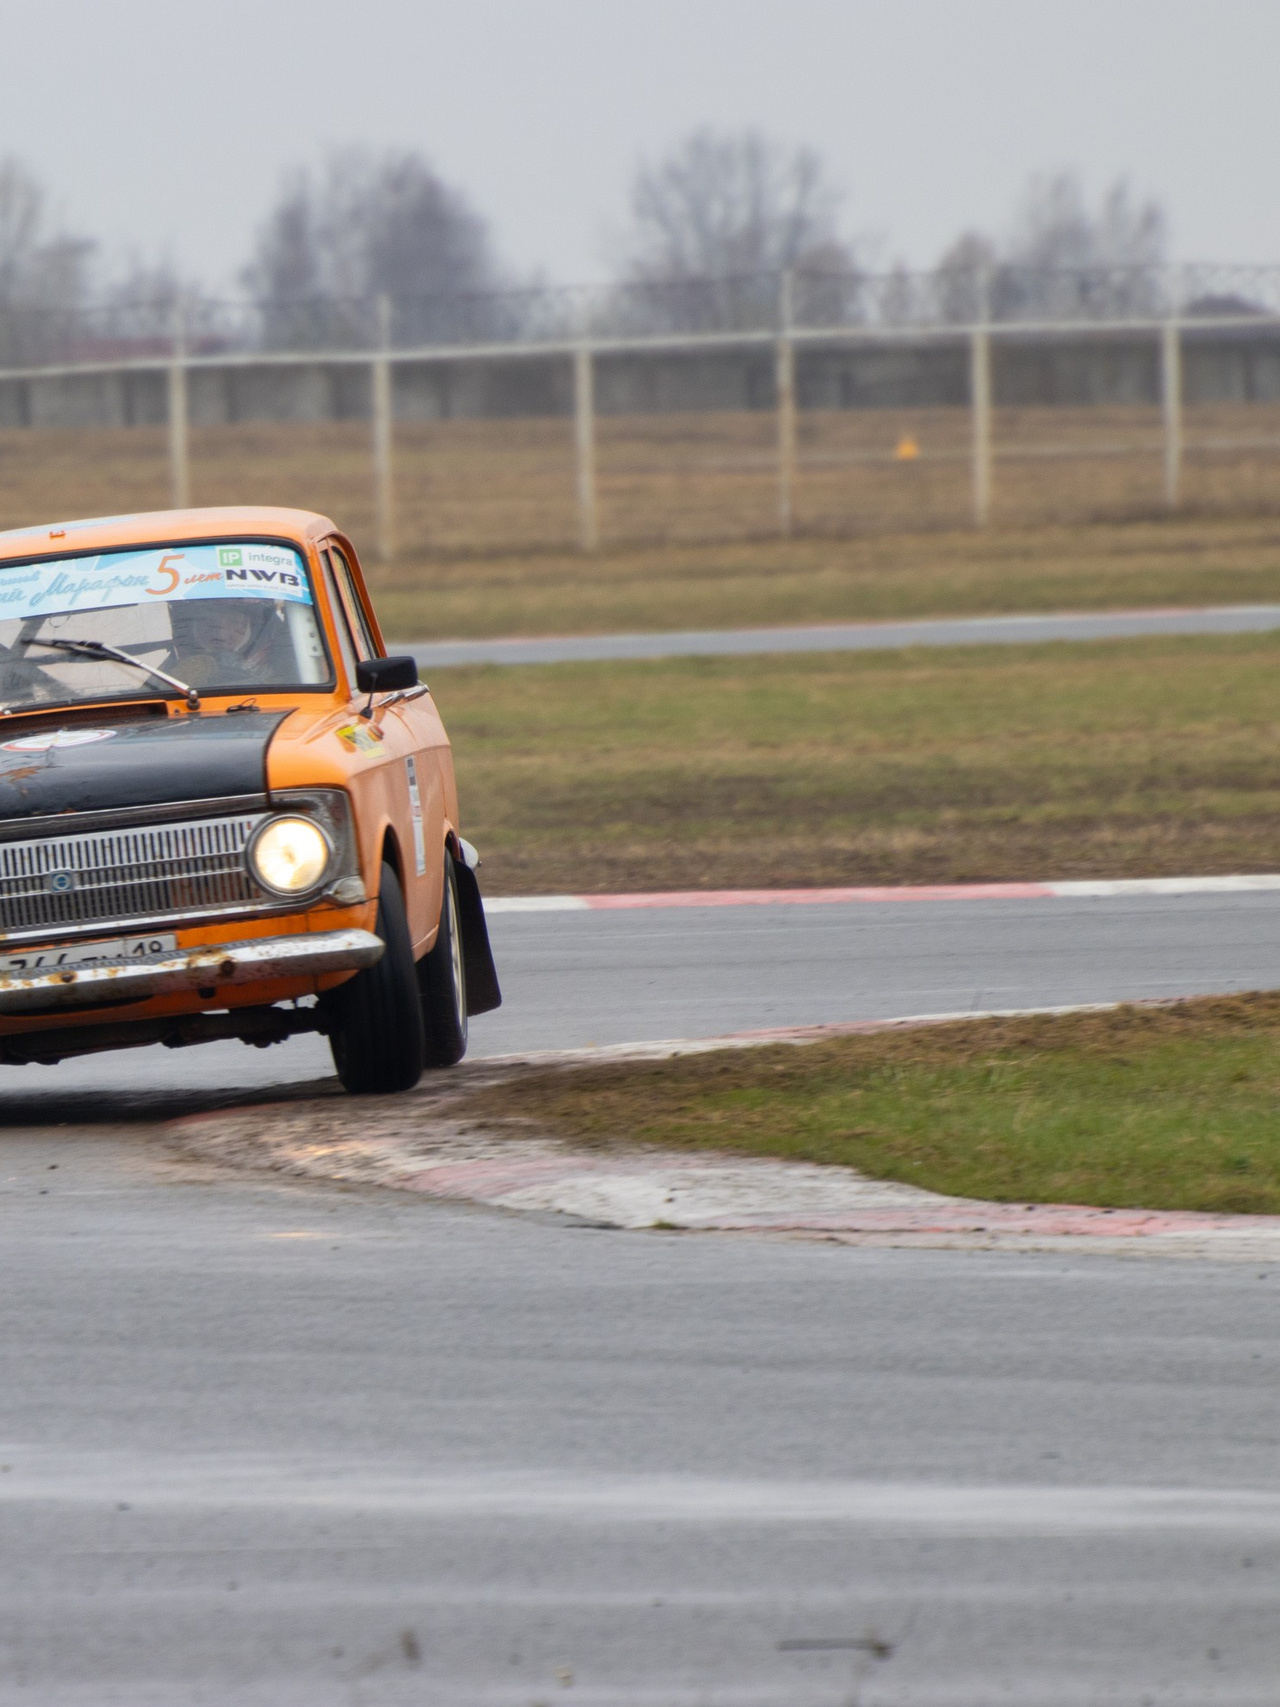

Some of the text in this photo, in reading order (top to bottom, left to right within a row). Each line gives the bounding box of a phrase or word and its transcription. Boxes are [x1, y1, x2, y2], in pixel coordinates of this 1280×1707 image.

[248, 553, 293, 566] integra
[145, 554, 185, 595] 5
[226, 569, 300, 587] NWB
